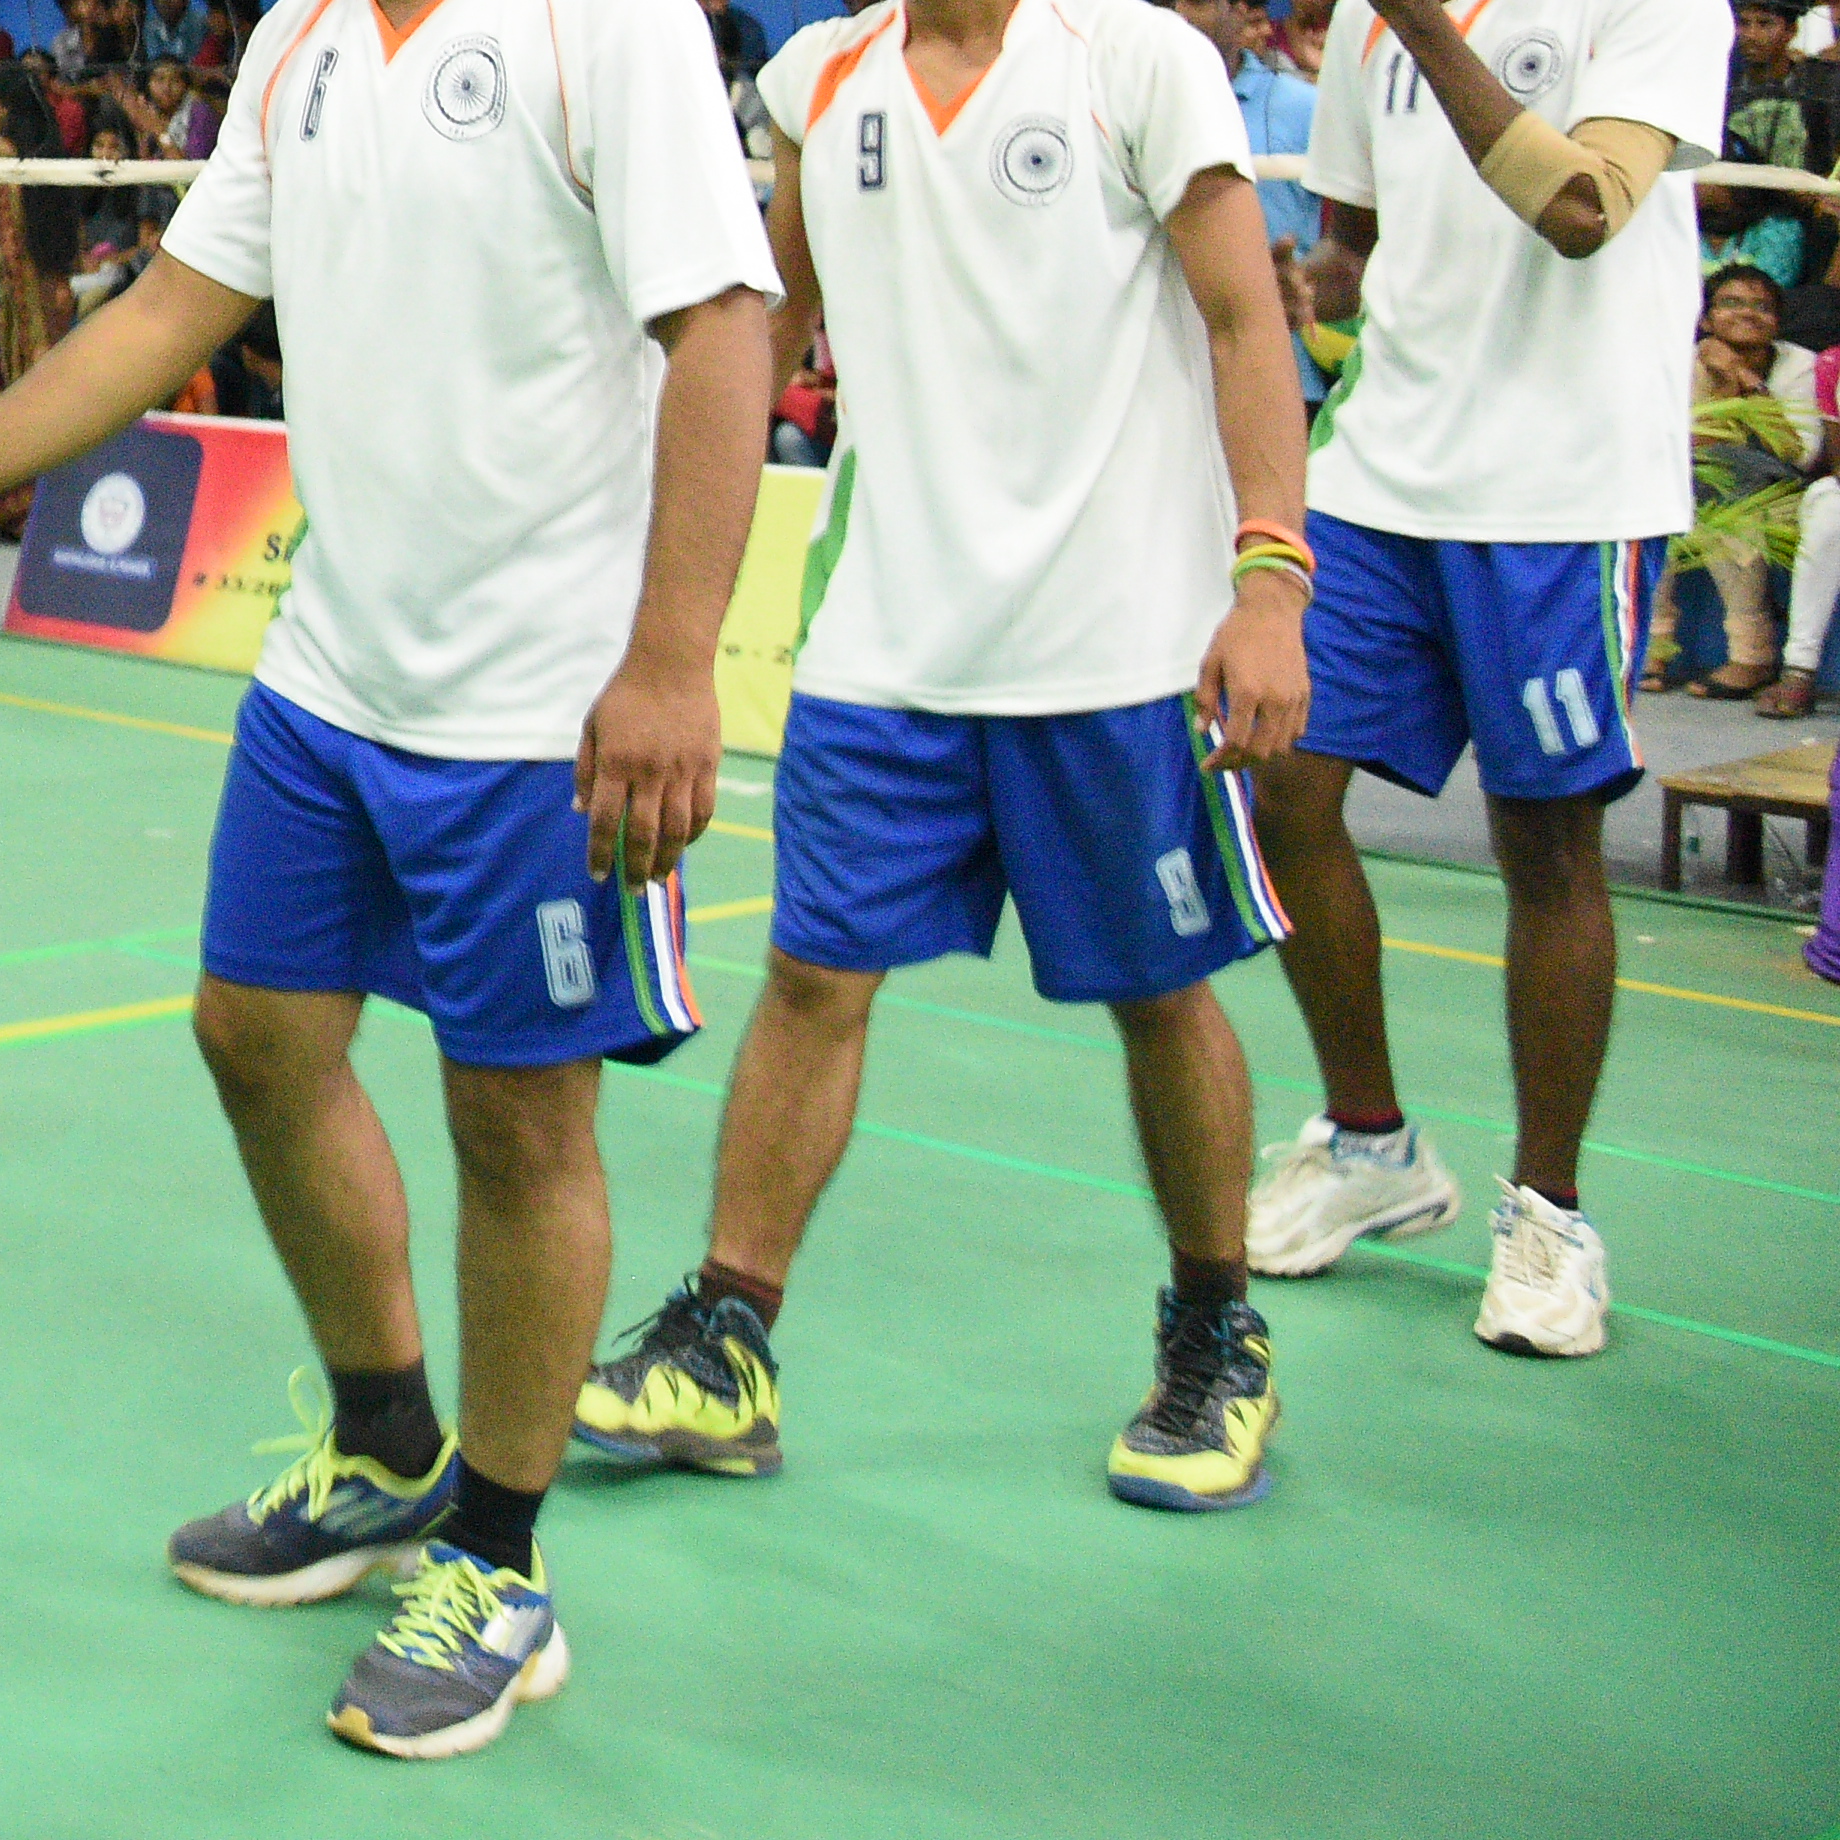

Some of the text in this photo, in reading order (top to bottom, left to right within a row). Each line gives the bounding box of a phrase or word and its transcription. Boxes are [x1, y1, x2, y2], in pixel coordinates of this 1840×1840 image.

[858, 110, 887, 192] 9
[1523, 667, 1601, 756] 11
[536, 898, 595, 1007] 6
